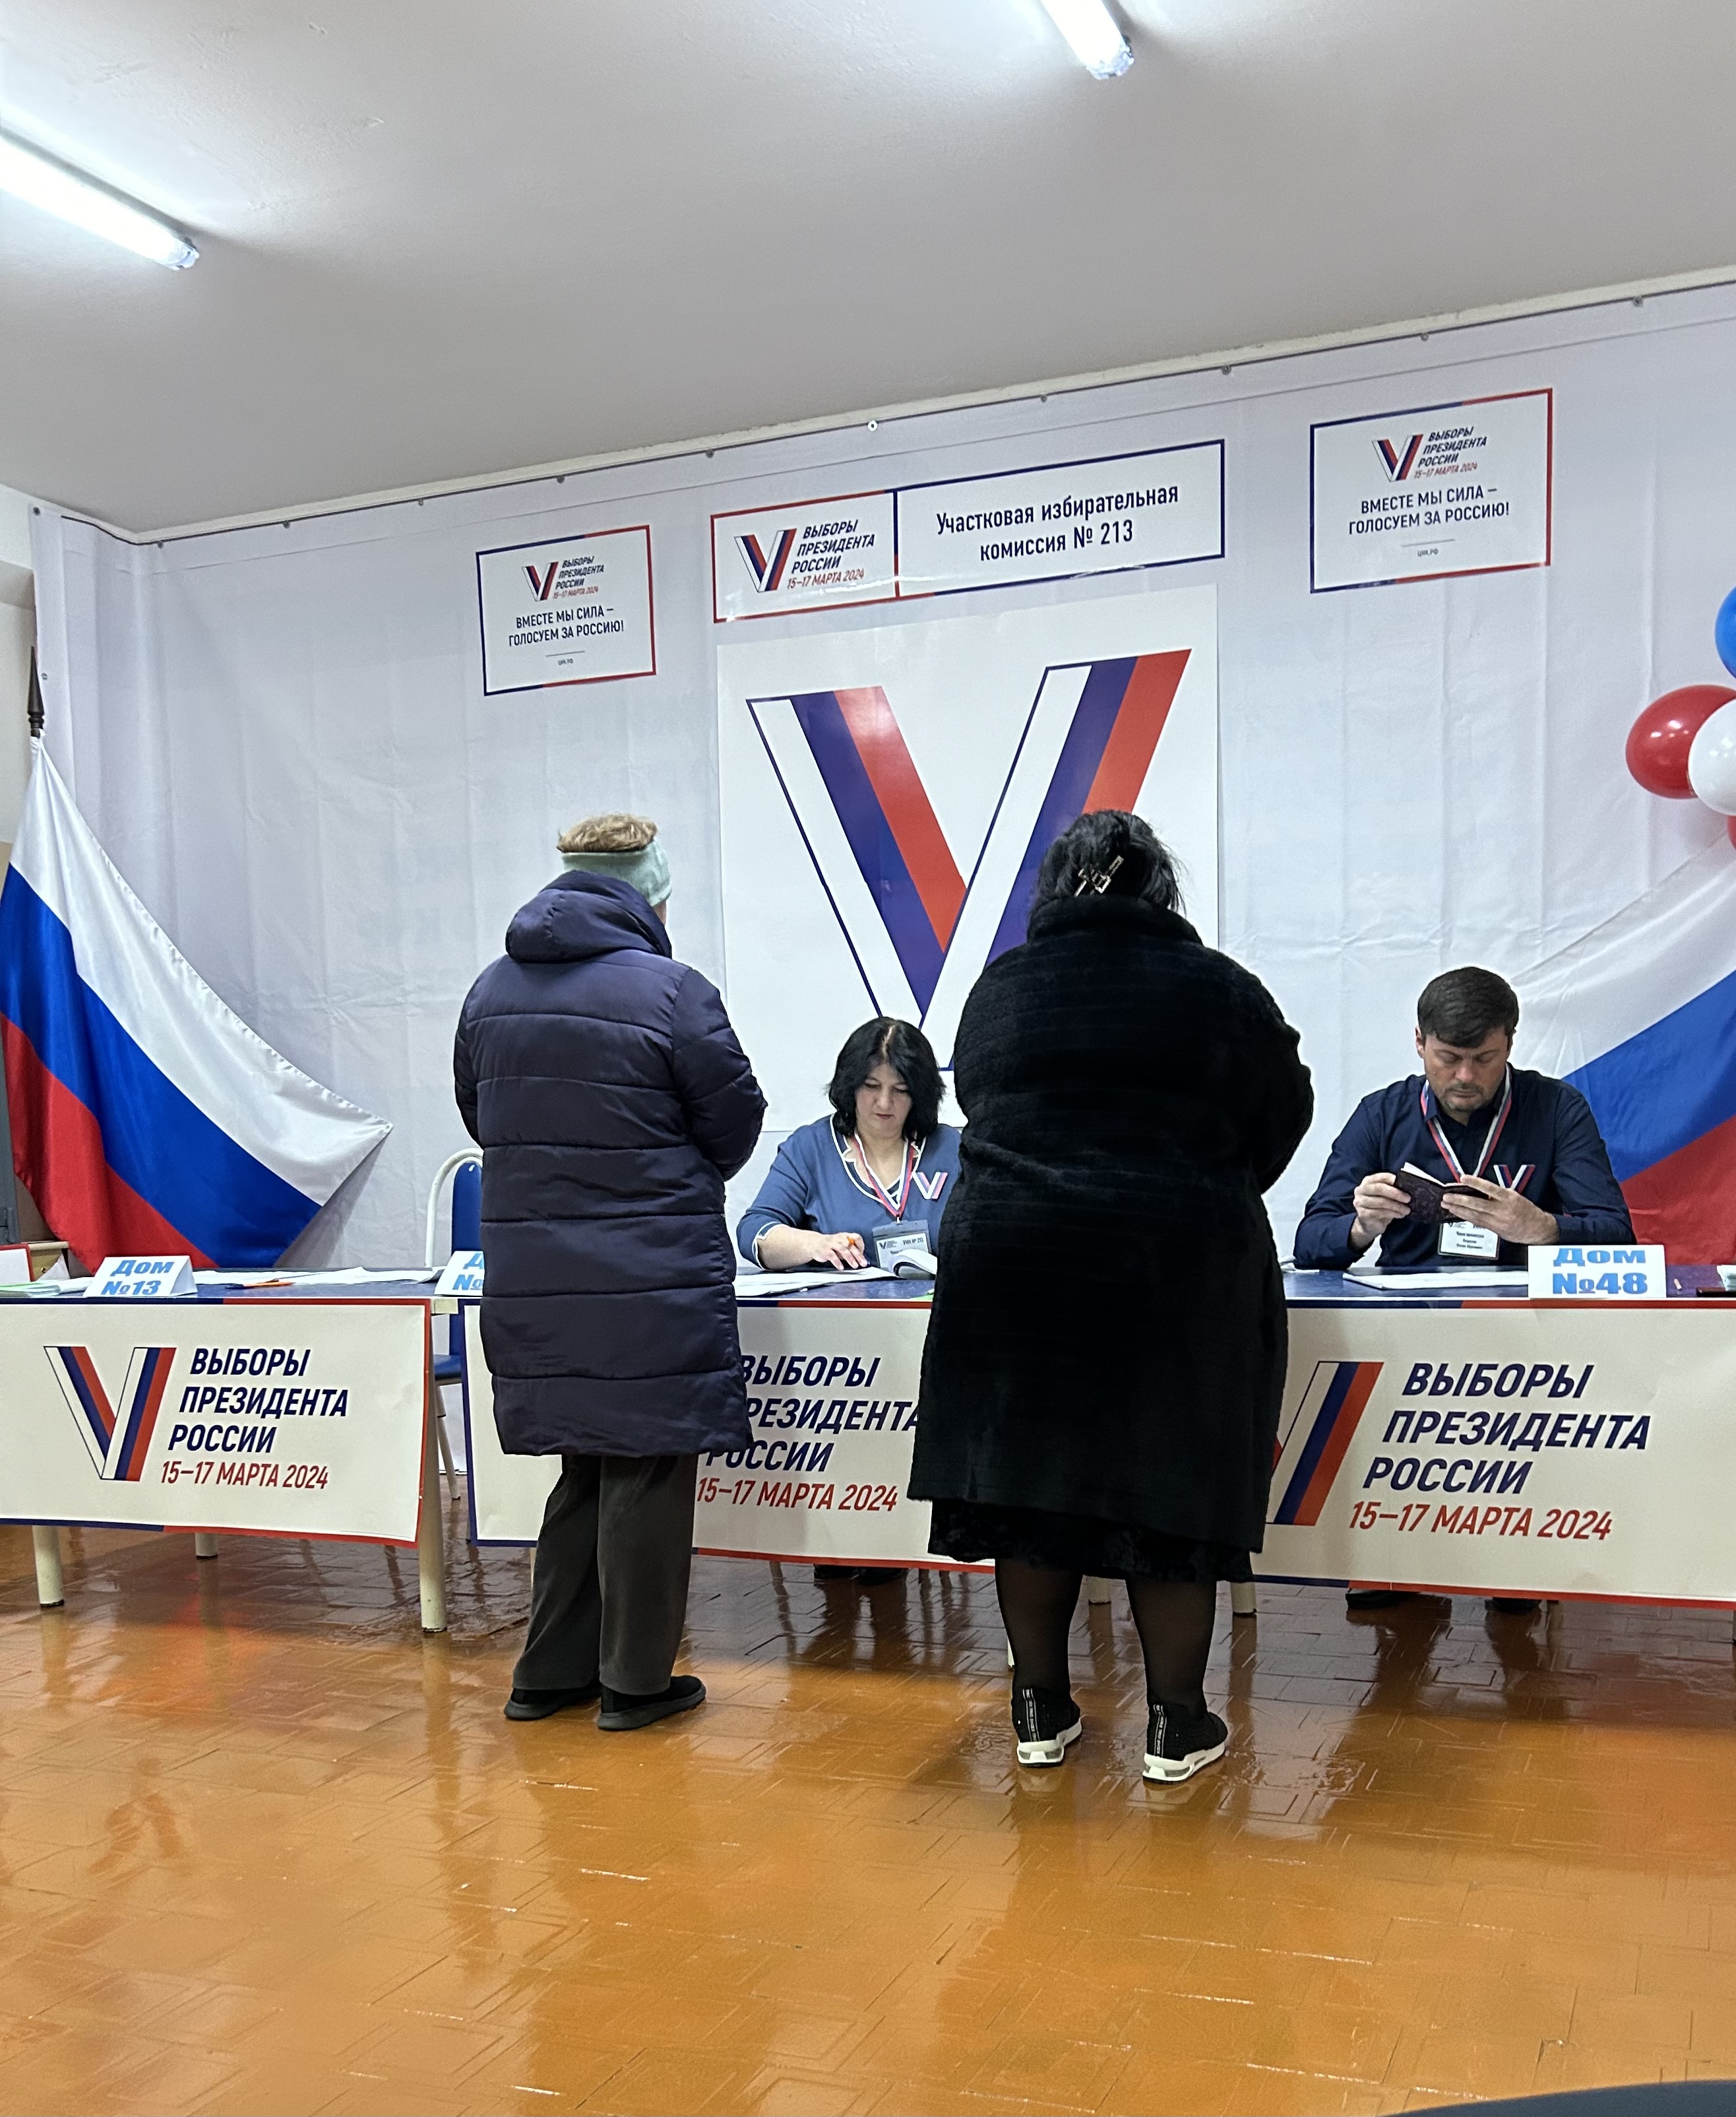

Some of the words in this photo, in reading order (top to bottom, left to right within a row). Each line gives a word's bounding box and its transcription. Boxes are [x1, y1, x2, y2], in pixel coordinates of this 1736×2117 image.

[1423, 437, 1487, 455] ПРЕЗИДЕНТА
[1429, 426, 1474, 442] ВЫБОРЫ
[1418, 453, 1459, 468] РОССИИ
[1435, 464, 1459, 476] МАРТА
[936, 506, 1034, 535] Участковая
[1041, 486, 1179, 521] избирательная
[1361, 494, 1413, 514] ВМЕСТЕ
[1418, 490, 1442, 507] МЫ
[1446, 485, 1483, 503] СИЛА
[803, 519, 858, 539] ВЫБОРЫ
[1349, 512, 1419, 535] ГОЛОСУЕМ
[1424, 511, 1441, 525] ЗА
[1445, 501, 1509, 522] РОССИЮ!
[797, 534, 875, 557] ПРЕЗИДЕНТА
[980, 534, 1066, 561] комиссия
[1074, 526, 1093, 548] №
[1100, 519, 1133, 545] 213
[558, 565, 604, 579] ПРЕЗИДЕНТА
[562, 555, 595, 568] ВЫБОРЫ
[791, 555, 841, 574] РОССИИ
[555, 578, 584, 590] РОССИИ
[812, 572, 841, 586] МАРТА
[843, 568, 865, 581] 2024
[516, 612, 553, 629] ВМЕСТЕ
[556, 609, 573, 622] МЫ
[576, 605, 604, 619] СИЛА
[509, 628, 559, 647] ГОЛОСУЕМ
[561, 626, 574, 639] ЗА
[576, 620, 624, 637] РОССИЮ!
[109, 1260, 175, 1277] Дом
[1553, 1248, 1646, 1267] Дом
[100, 1280, 161, 1296] №13
[1552, 1271, 1648, 1295] №48
[190, 1348, 311, 1377] ВЫБОРЫ
[1402, 1362, 1594, 1399] ВЫБОРЫ
[179, 1387, 349, 1419] ПРЕЗИДЕНТА
[747, 1398, 920, 1434] РЕЗИДЕНТА
[168, 1424, 277, 1453] РОССИИ
[1382, 1410, 1650, 1452] ПРЕЗИДЕНТА
[216, 1462, 278, 1488] МАРТА
[282, 1464, 329, 1490] 2024
[1362, 1457, 1533, 1494] РОССИИ
[756, 1480, 835, 1510] МАРТА
[838, 1484, 898, 1512] 2024
[1430, 1505, 1534, 1536] МАРТА
[1537, 1509, 1613, 1540] 2024
